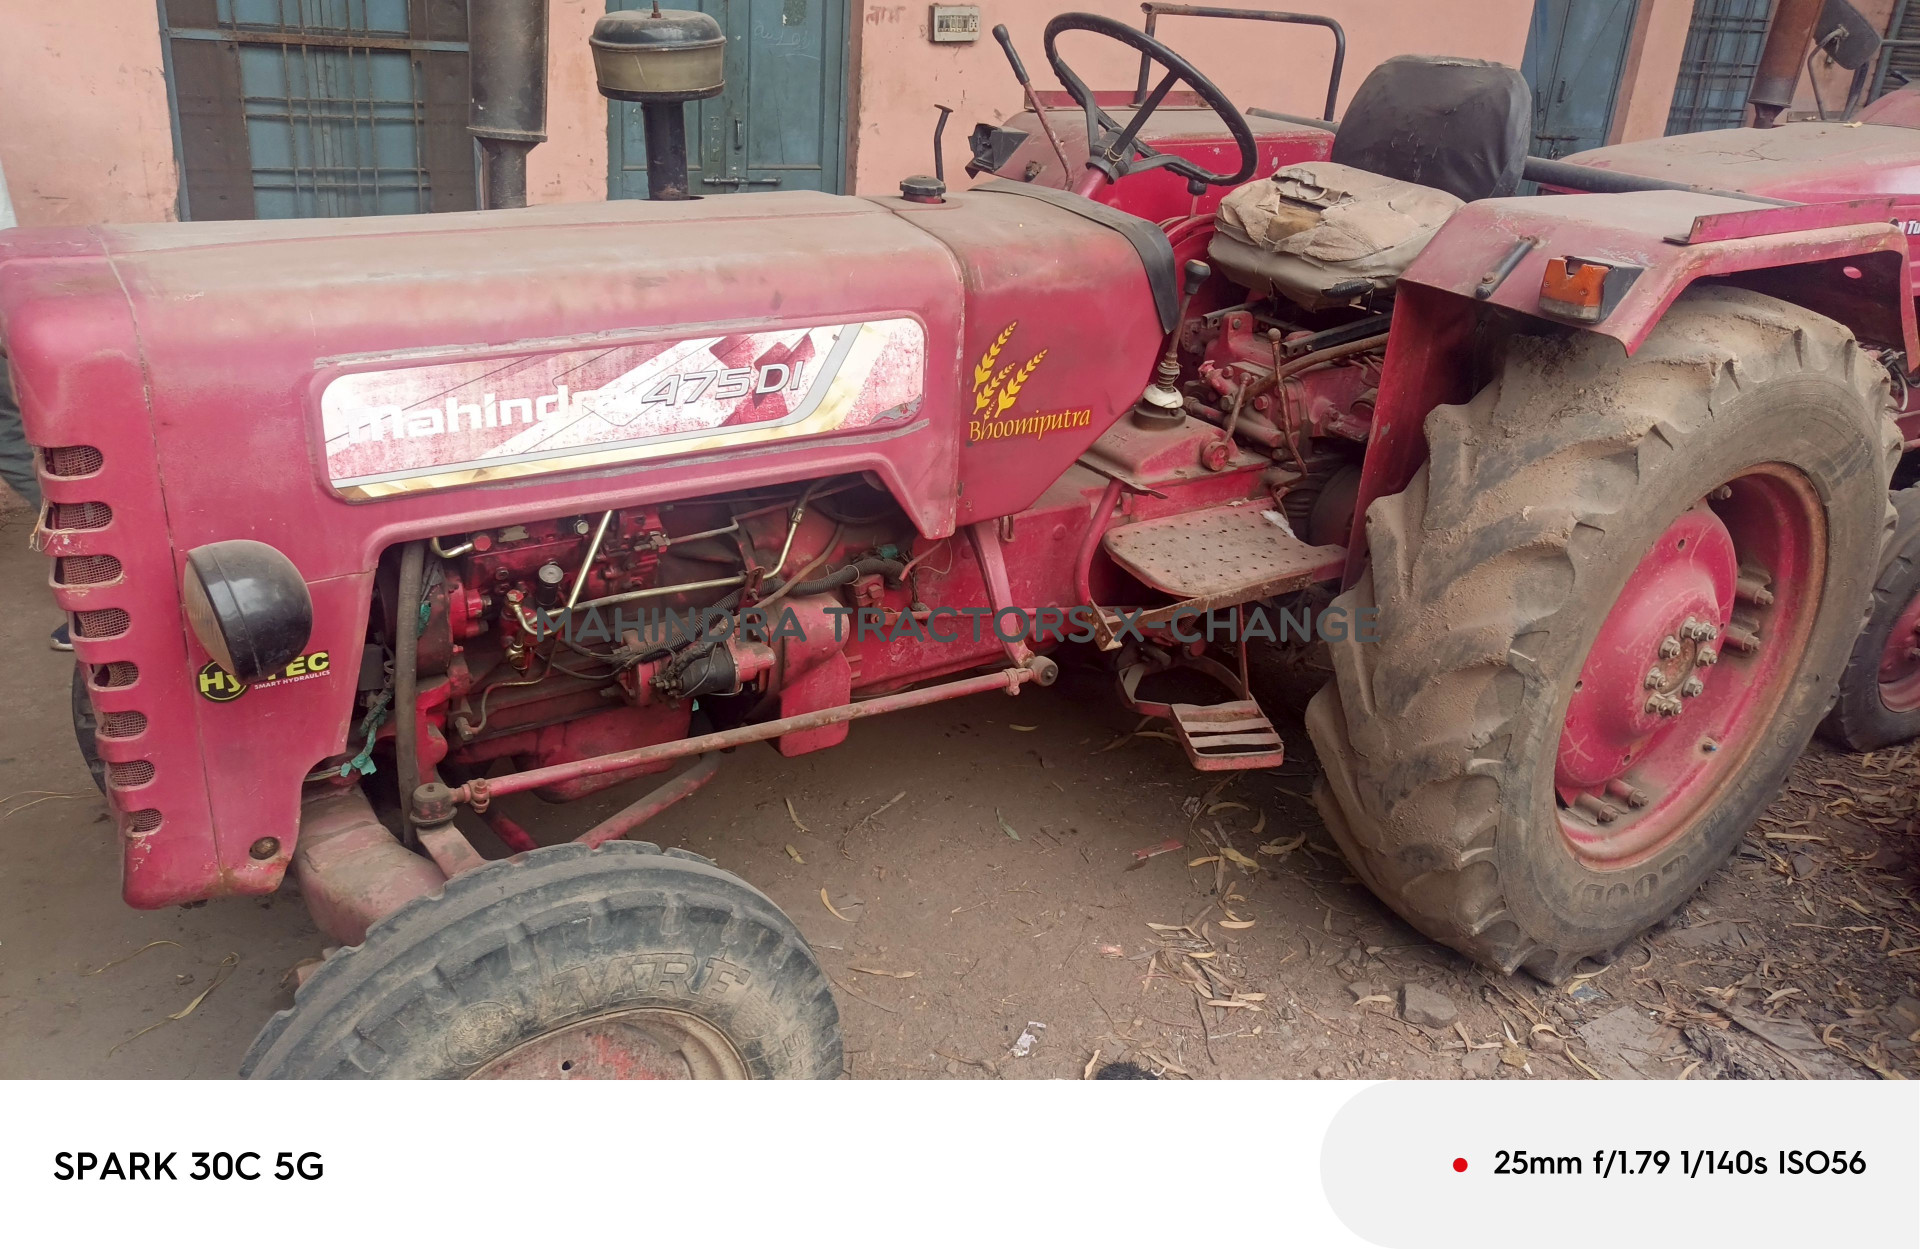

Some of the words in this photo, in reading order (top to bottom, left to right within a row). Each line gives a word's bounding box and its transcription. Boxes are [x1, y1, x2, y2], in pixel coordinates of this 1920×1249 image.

[969, 409, 1091, 441] Bhoomiputra
[254, 680, 282, 691] SMART
[283, 670, 331, 685] HYDRAULICS
[552, 952, 751, 1013] MRF
